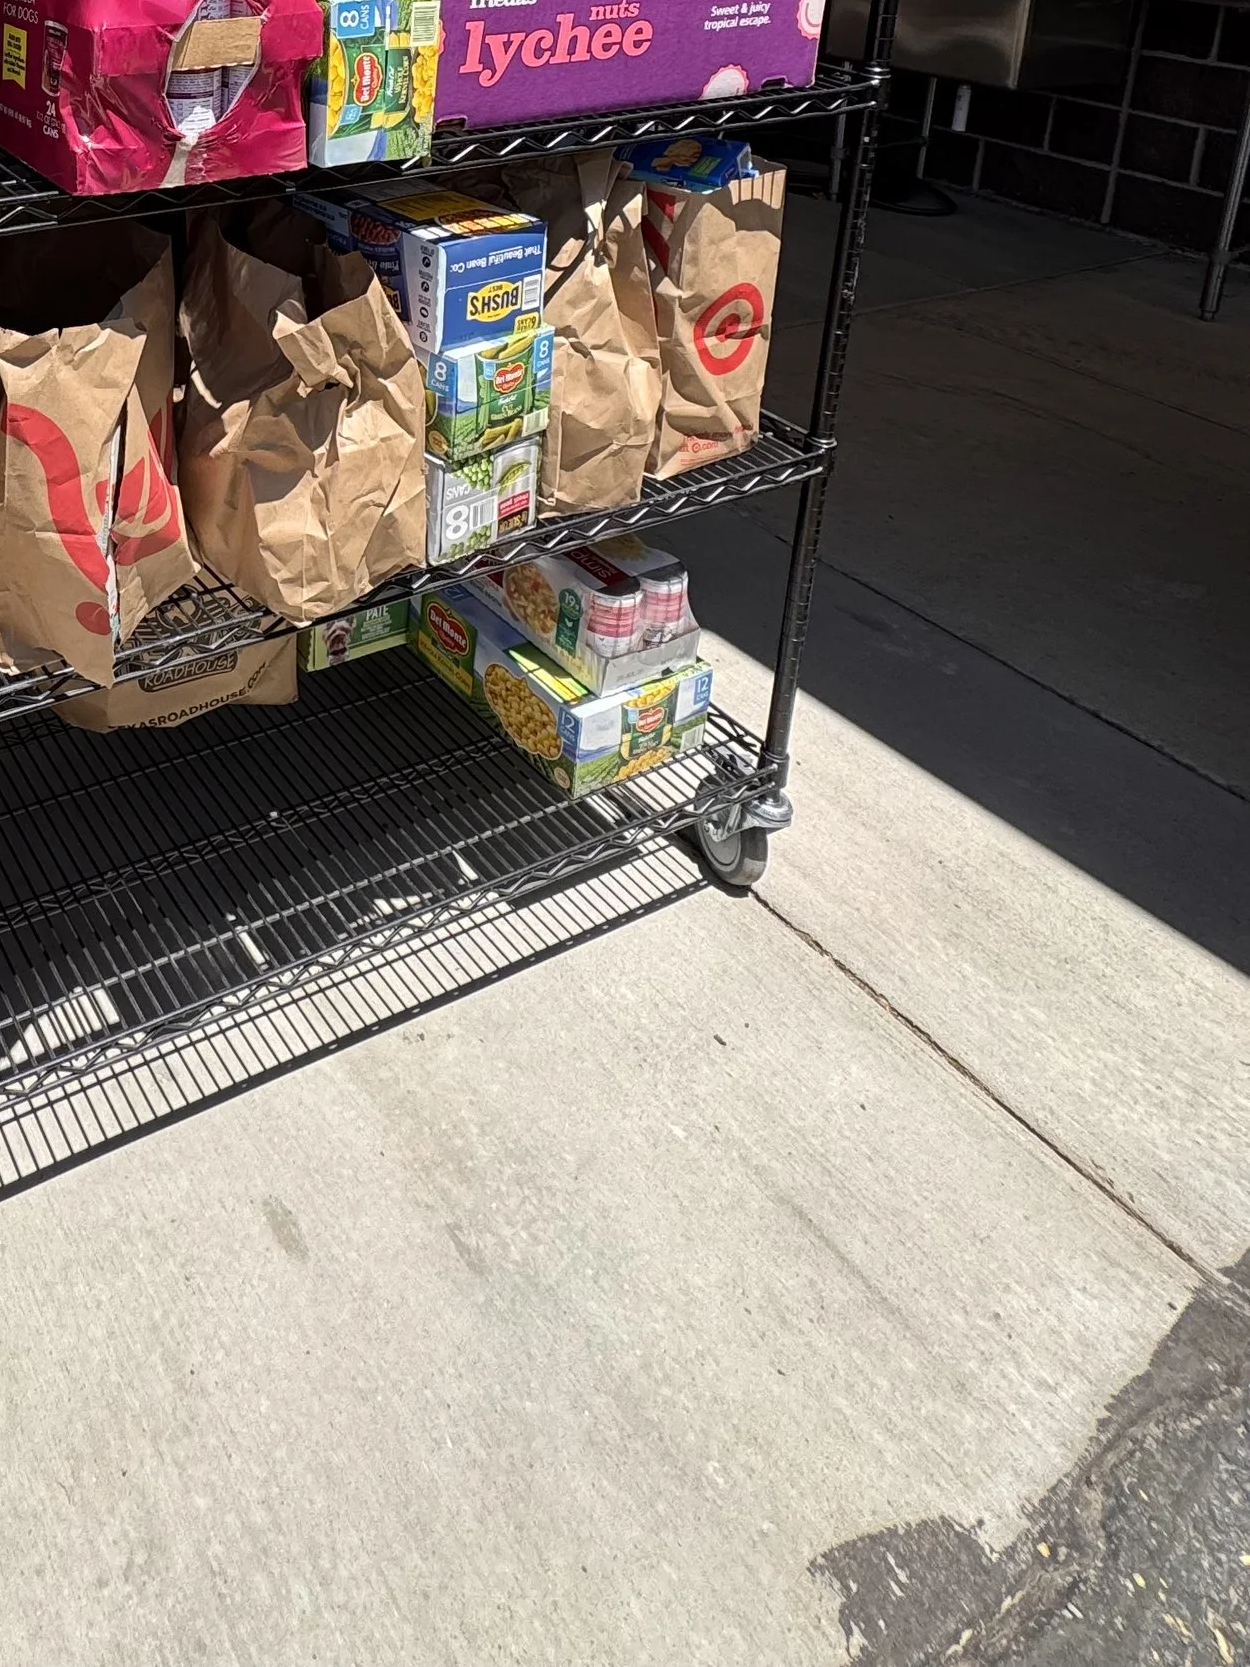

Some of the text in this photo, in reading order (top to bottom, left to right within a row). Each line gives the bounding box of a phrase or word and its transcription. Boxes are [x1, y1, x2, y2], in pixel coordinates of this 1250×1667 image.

[3, 1, 39, 25] FOR DOGS
[340, 4, 370, 30] 8 CANS
[710, 1, 771, 17] Sweet & juicy
[704, 15, 771, 32] tropical escape.
[458, 13, 654, 88] lychee
[360, 56, 372, 103] Del Monte
[46, 100, 57, 118] 24
[43, 124, 59, 140] CANS
[465, 243, 542, 269] That Beautiful Bean
[488, 284, 504, 293] BEST
[469, 285, 520, 316] BUSH'S
[539, 340, 550, 359] 8
[435, 361, 448, 382] 8
[430, 379, 450, 393] CANS
[446, 484, 470, 501] CANS
[445, 504, 470, 541] 8
[429, 608, 467, 649] Del Monte
[143, 653, 236, 689] ROADHOUSE
[697, 676, 709, 692] 12
[560, 710, 577, 733] 12
